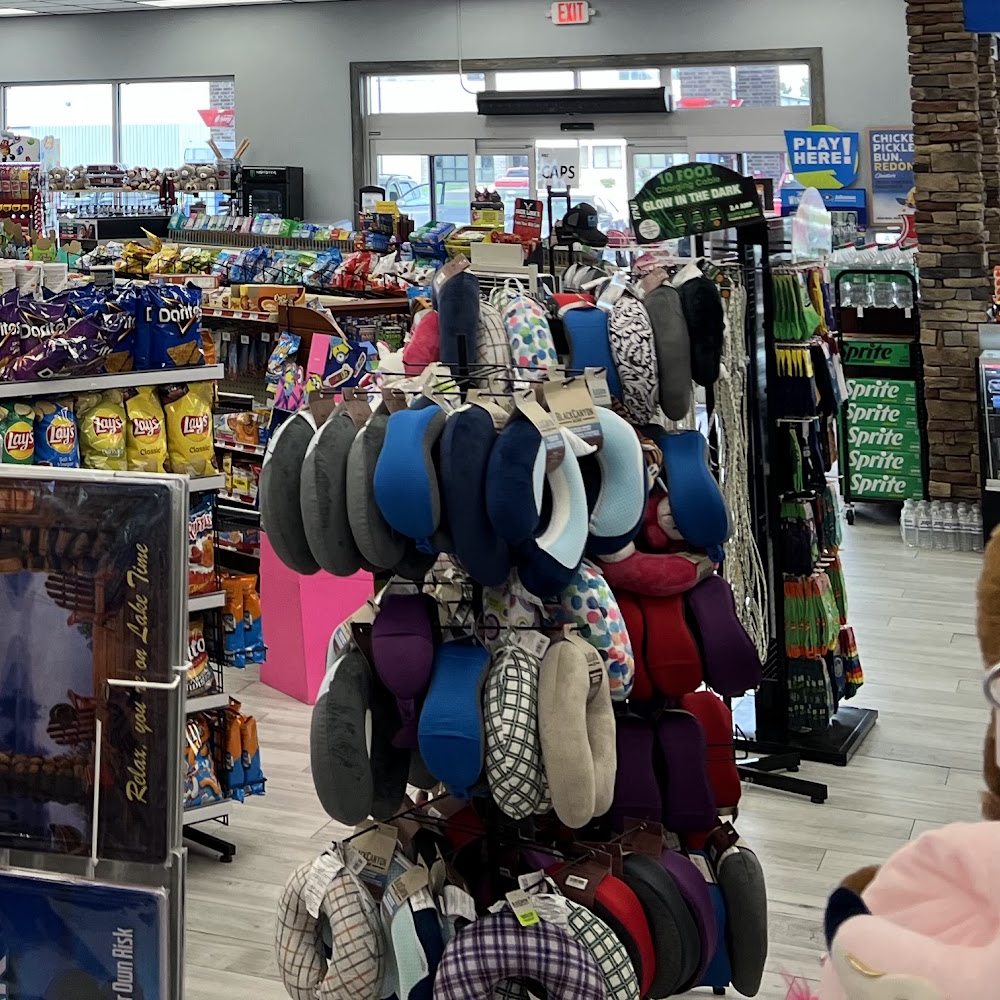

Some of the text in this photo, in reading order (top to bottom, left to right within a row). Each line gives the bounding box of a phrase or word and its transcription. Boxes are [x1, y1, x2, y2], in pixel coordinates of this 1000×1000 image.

[558, 2, 584, 23] EXIT
[793, 137, 840, 151] PLAY
[872, 134, 914, 144] CHICKE
[873, 144, 915, 152] PICKLE
[873, 153, 903, 162] BUN.
[874, 162, 914, 172] REDON
[542, 165, 575, 179] CAPS
[658, 164, 713, 185] 10 FOOT
[655, 176, 721, 194] Charging Cable
[642, 183, 742, 212] GLOW IN THE DARK
[846, 379, 899, 399] Sprite
[847, 403, 901, 423] Sprite
[49, 423, 76, 446] Lay's
[95, 415, 122, 435] Lay's
[133, 416, 160, 437] Lay's
[182, 414, 209, 436] Lay's
[6, 429, 34, 452] Lay's
[848, 426, 904, 447] Sprite
[140, 448, 161, 457] Classic
[189, 445, 211, 455] Classic
[849, 450, 905, 471] Sprite
[850, 473, 907, 494] Sprite
[126, 542, 149, 588] Time
[126, 593, 148, 645] Lake
[135, 648, 148, 670] on
[125, 744, 149, 804] Relax,
[357, 850, 388, 869] ACKCANYON
[112, 927, 134, 959] Risk
[112, 960, 134, 994] Own
